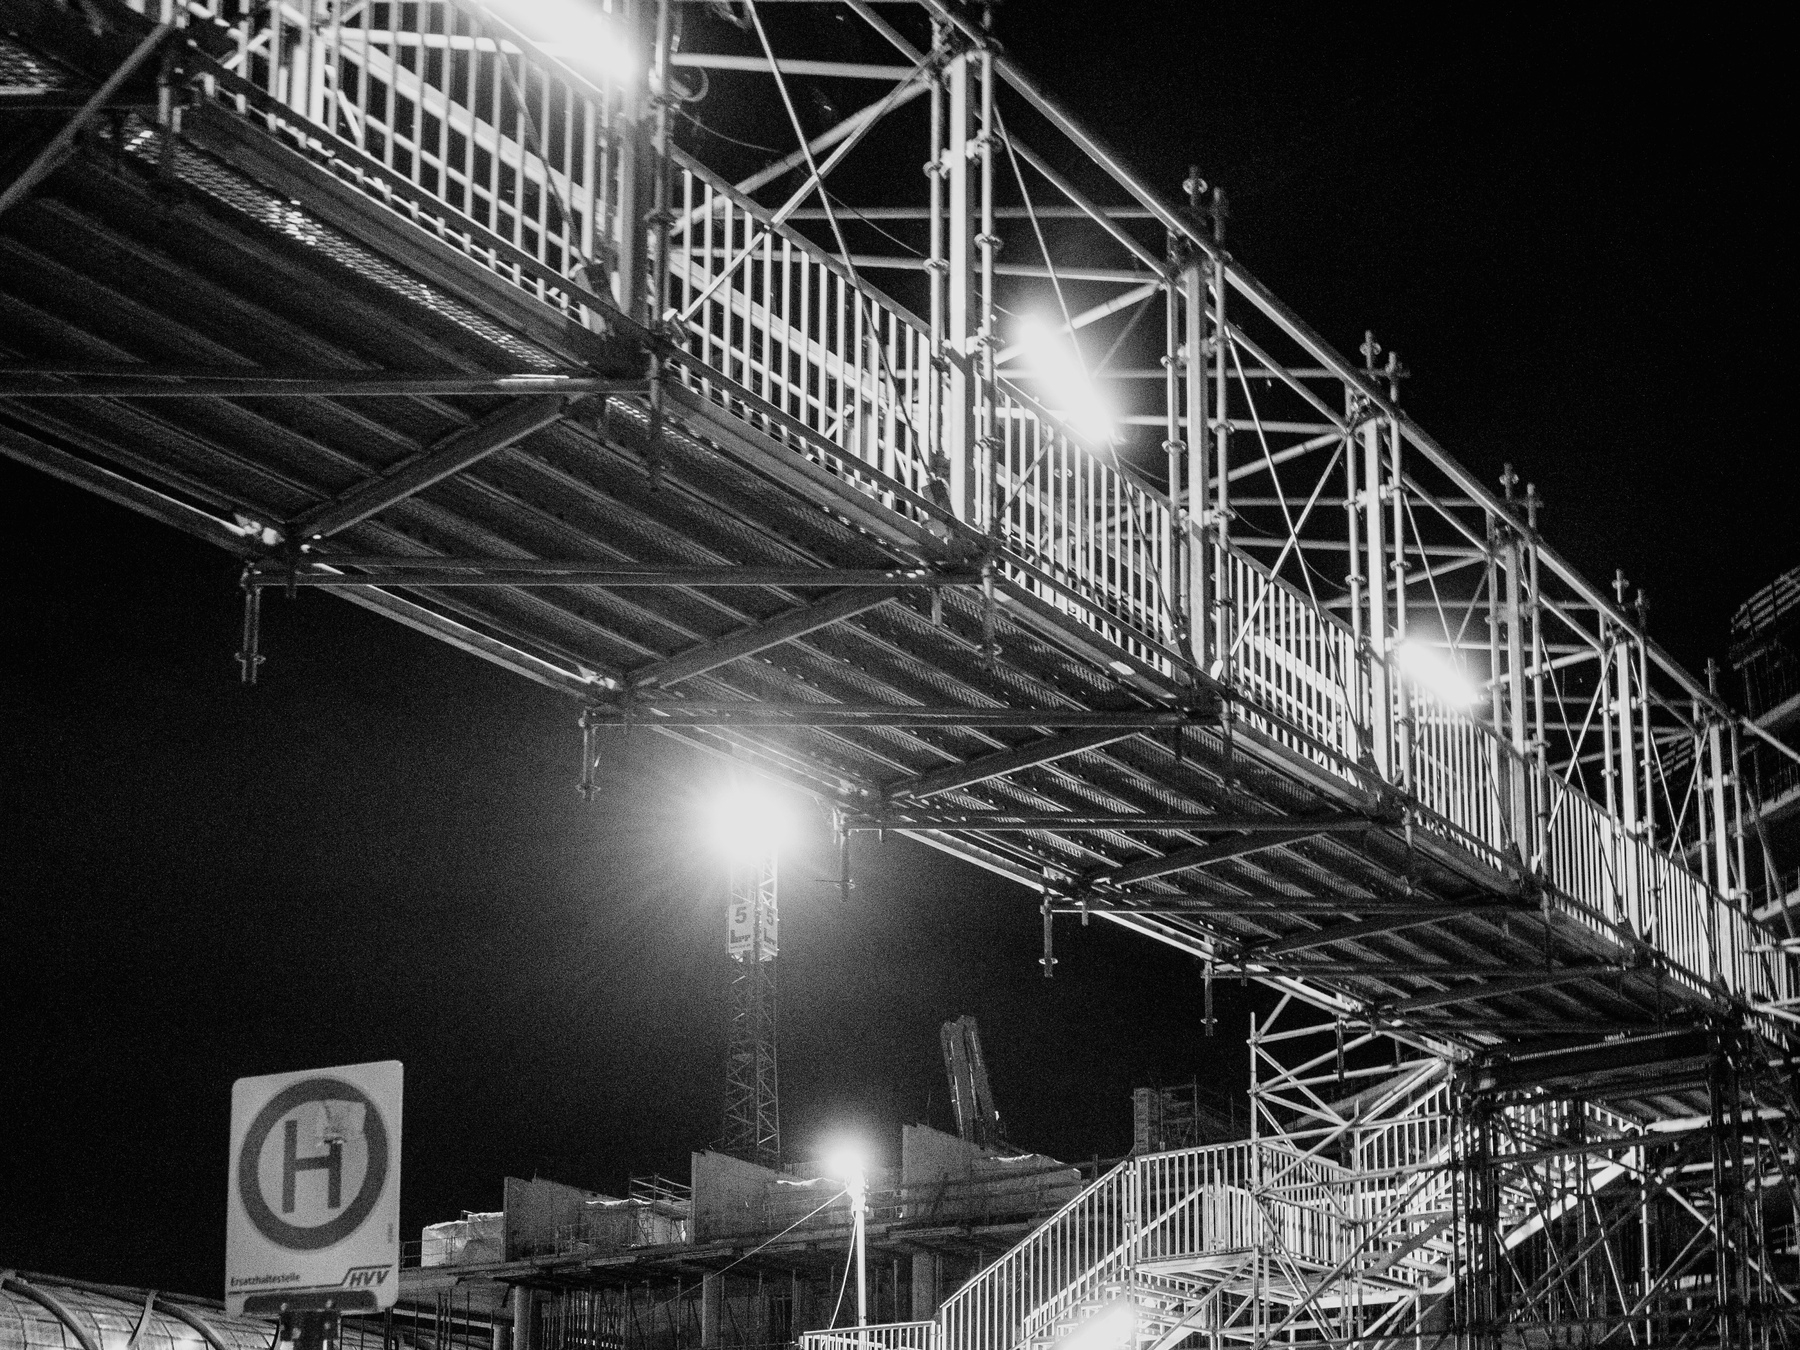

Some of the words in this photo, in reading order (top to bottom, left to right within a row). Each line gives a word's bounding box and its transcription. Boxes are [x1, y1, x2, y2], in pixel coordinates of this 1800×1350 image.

[735, 906, 747, 924] 5
[766, 907, 774, 927] 5
[282, 1120, 343, 1213] H
[230, 1272, 300, 1286] Ersatzhaltestelle
[350, 1270, 391, 1287] HVV
